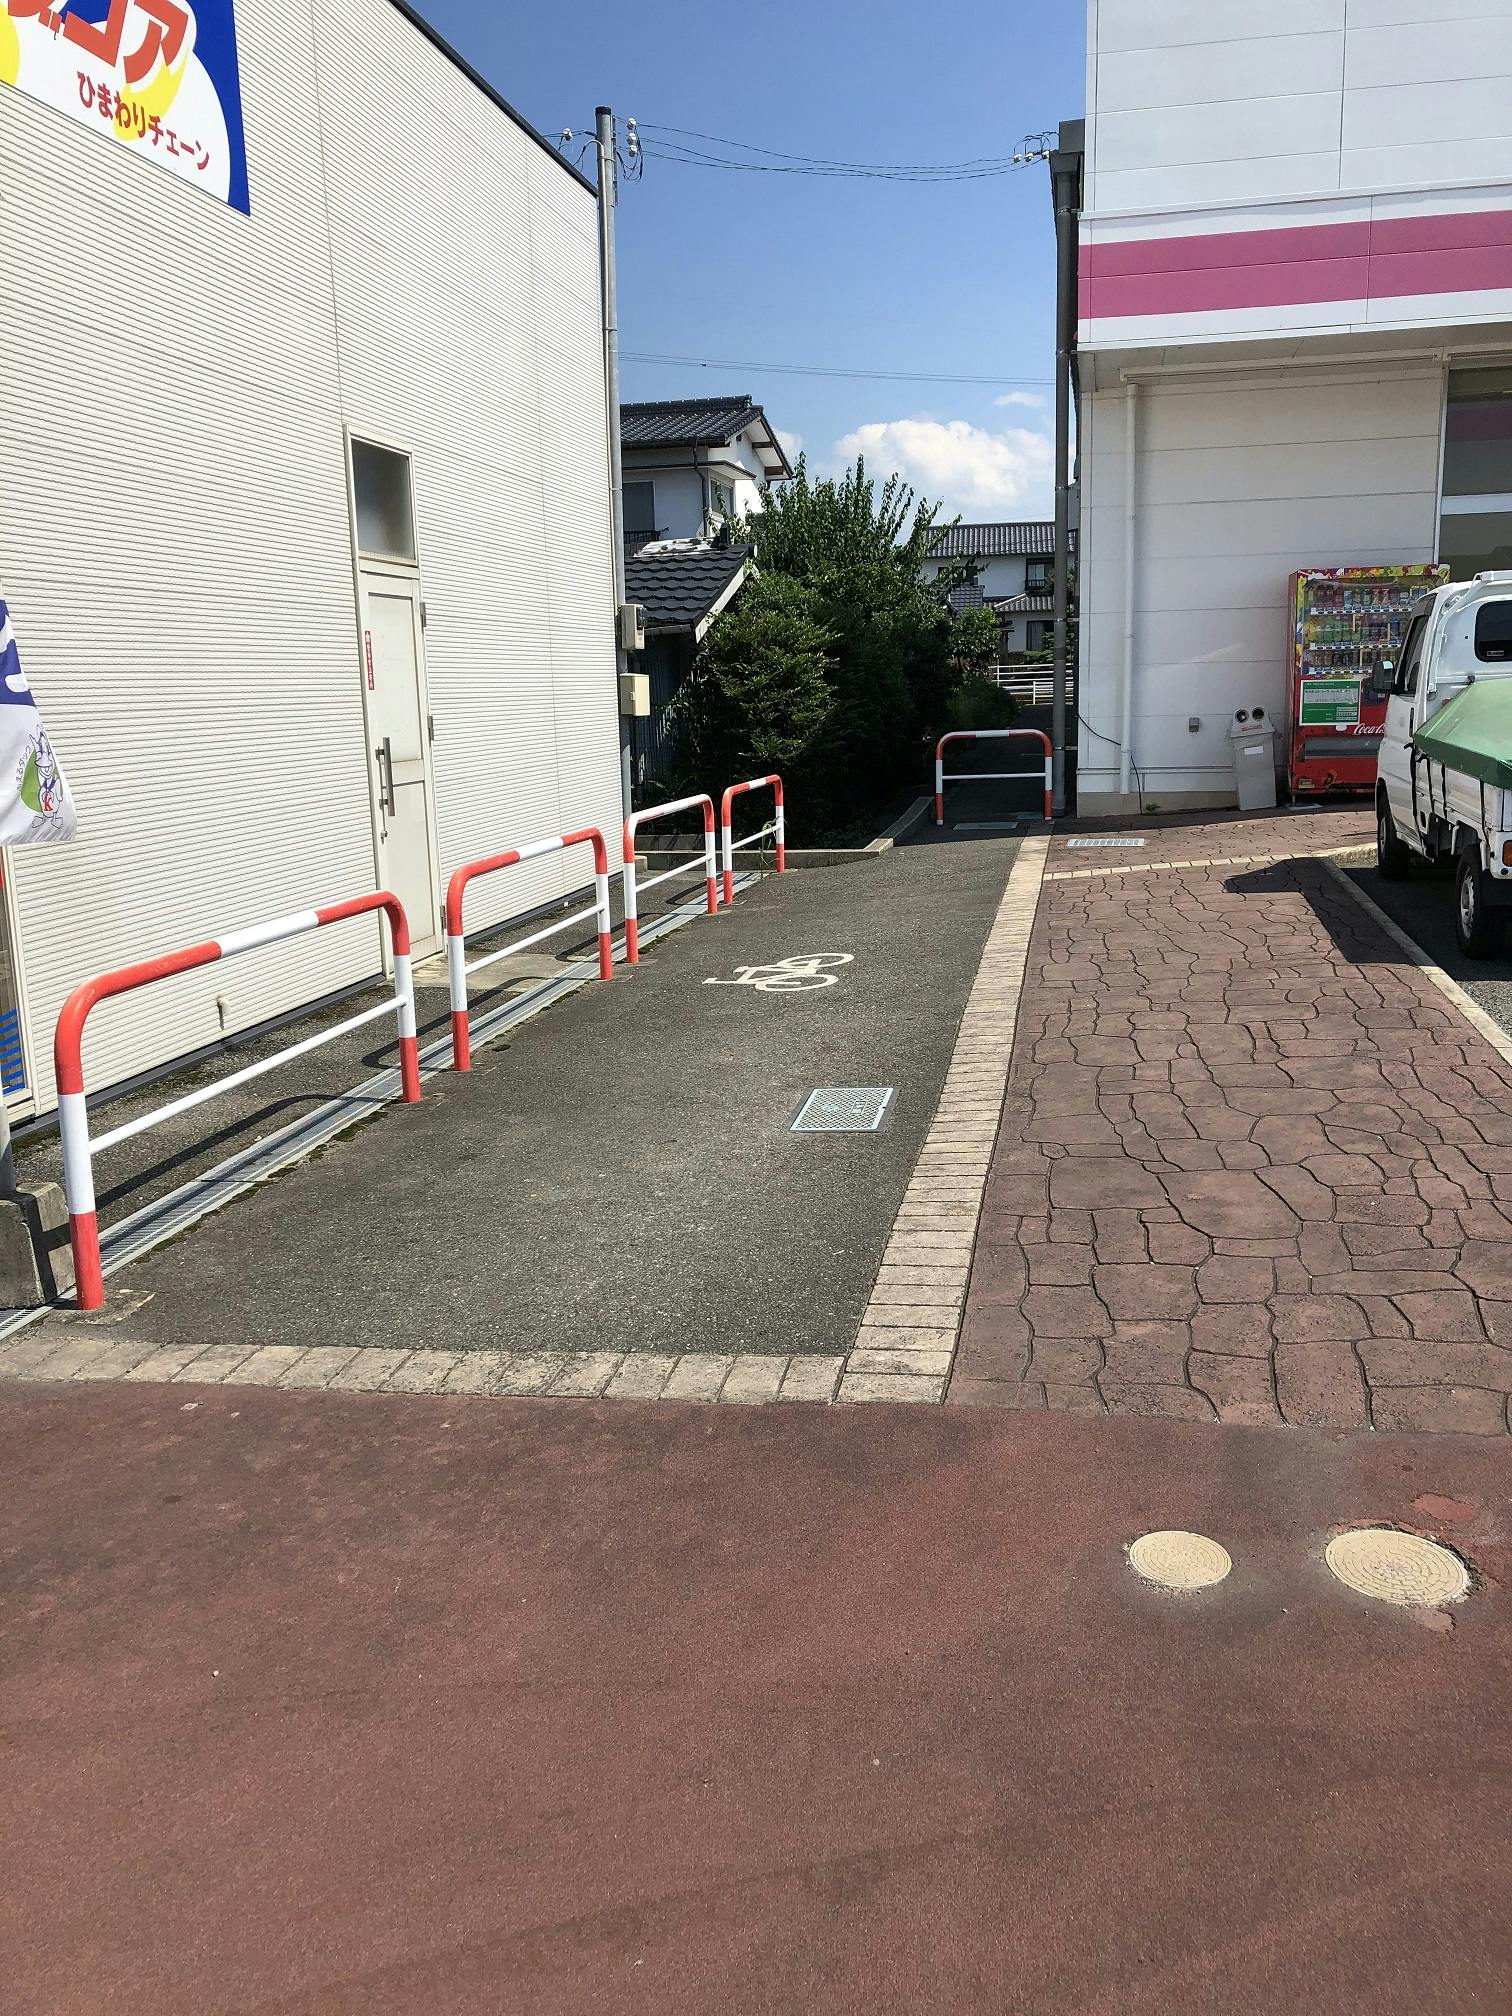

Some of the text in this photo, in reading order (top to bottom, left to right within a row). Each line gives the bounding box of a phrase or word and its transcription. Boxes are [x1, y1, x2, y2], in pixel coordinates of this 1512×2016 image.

[77, 70, 210, 170] ひまわりチェーン
